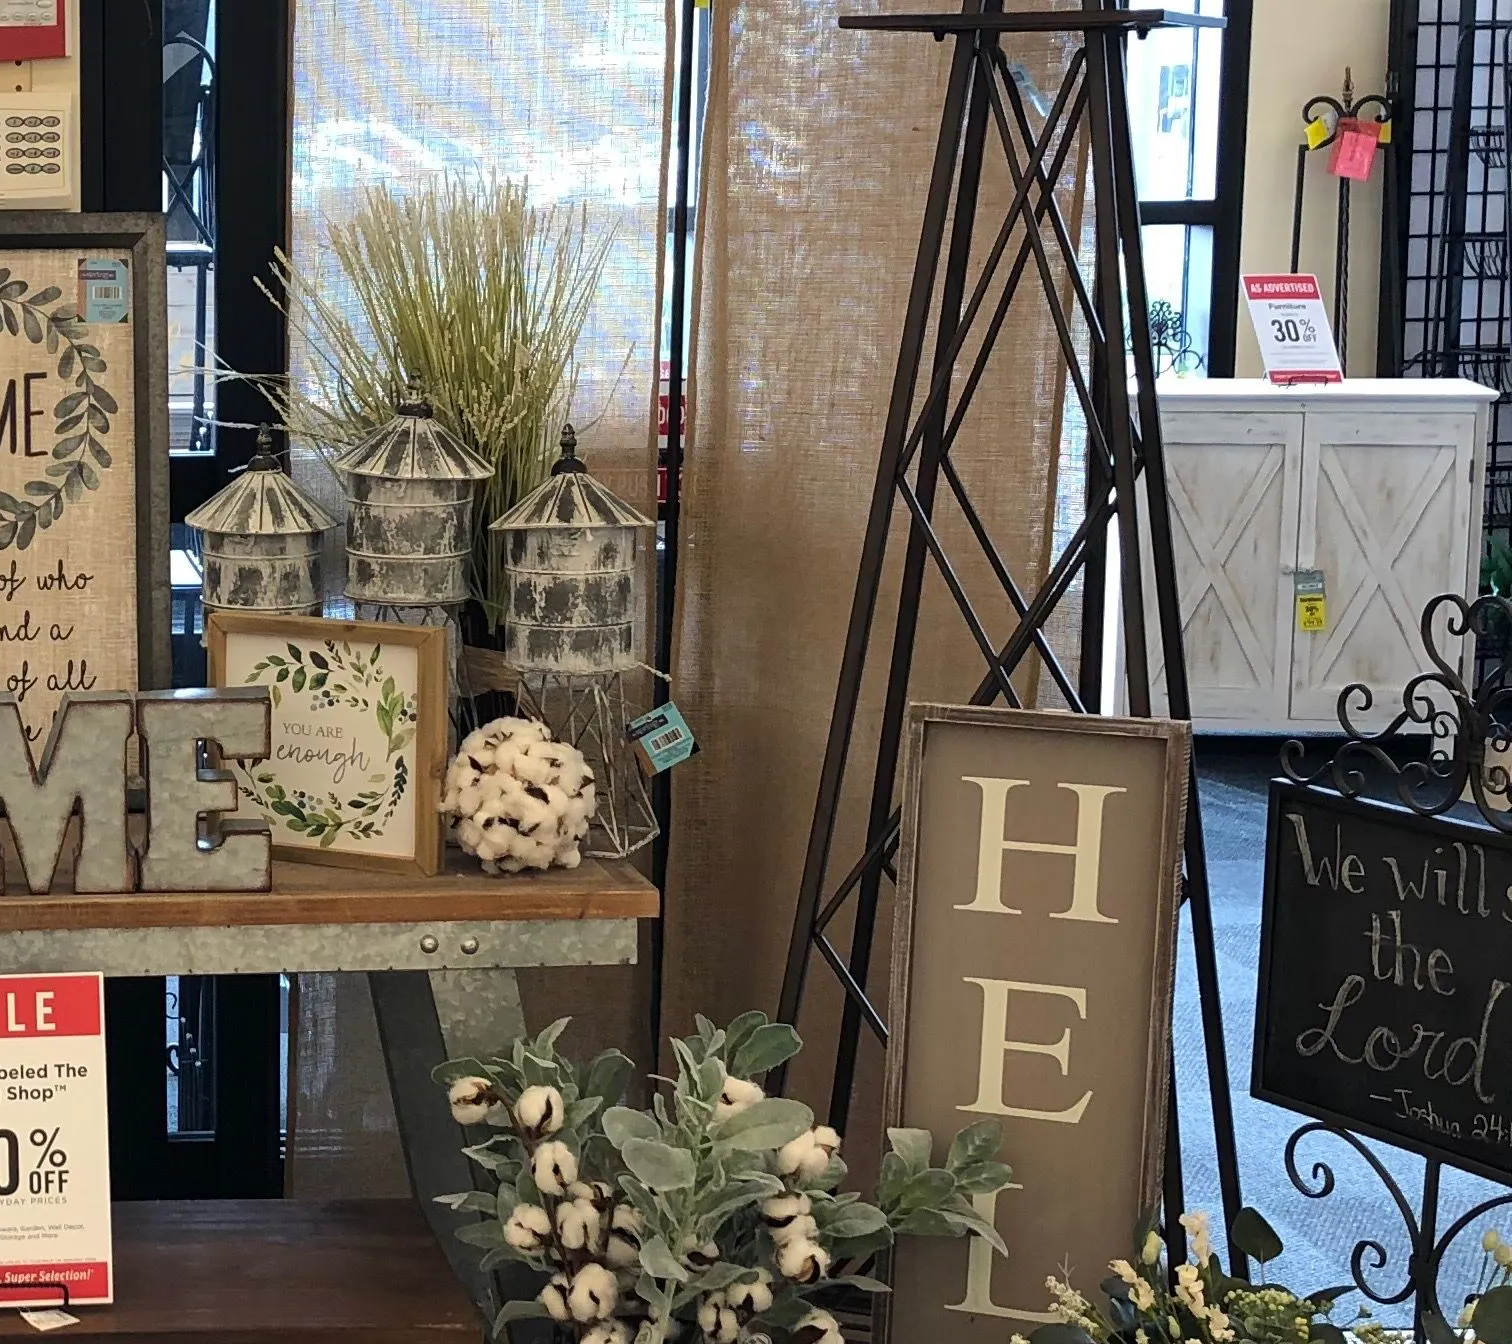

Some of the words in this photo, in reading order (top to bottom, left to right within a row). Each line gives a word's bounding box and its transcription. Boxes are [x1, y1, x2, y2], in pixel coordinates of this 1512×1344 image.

[1250, 283, 1263, 293] AS
[1263, 282, 1315, 293] ADVERTISED
[1268, 302, 1307, 310] Furniture
[36, 559, 94, 591] who
[49, 623, 74, 641] a
[6, 660, 38, 702] of
[46, 659, 98, 691] all
[282, 722, 312, 736] YOU
[314, 725, 344, 738] ARE
[276, 737, 371, 784] enough
[1285, 813, 1366, 894] We
[1382, 841, 1492, 918] will
[1363, 909, 1457, 996] the
[1295, 974, 1512, 1104] Lord
[54, 1063, 88, 1079] The
[29, 1170, 69, 1195] OFF
[30, 1196, 69, 1206] PRICES
[27, 1232, 40, 1240] and
[5, 1270, 37, 1284] Super
